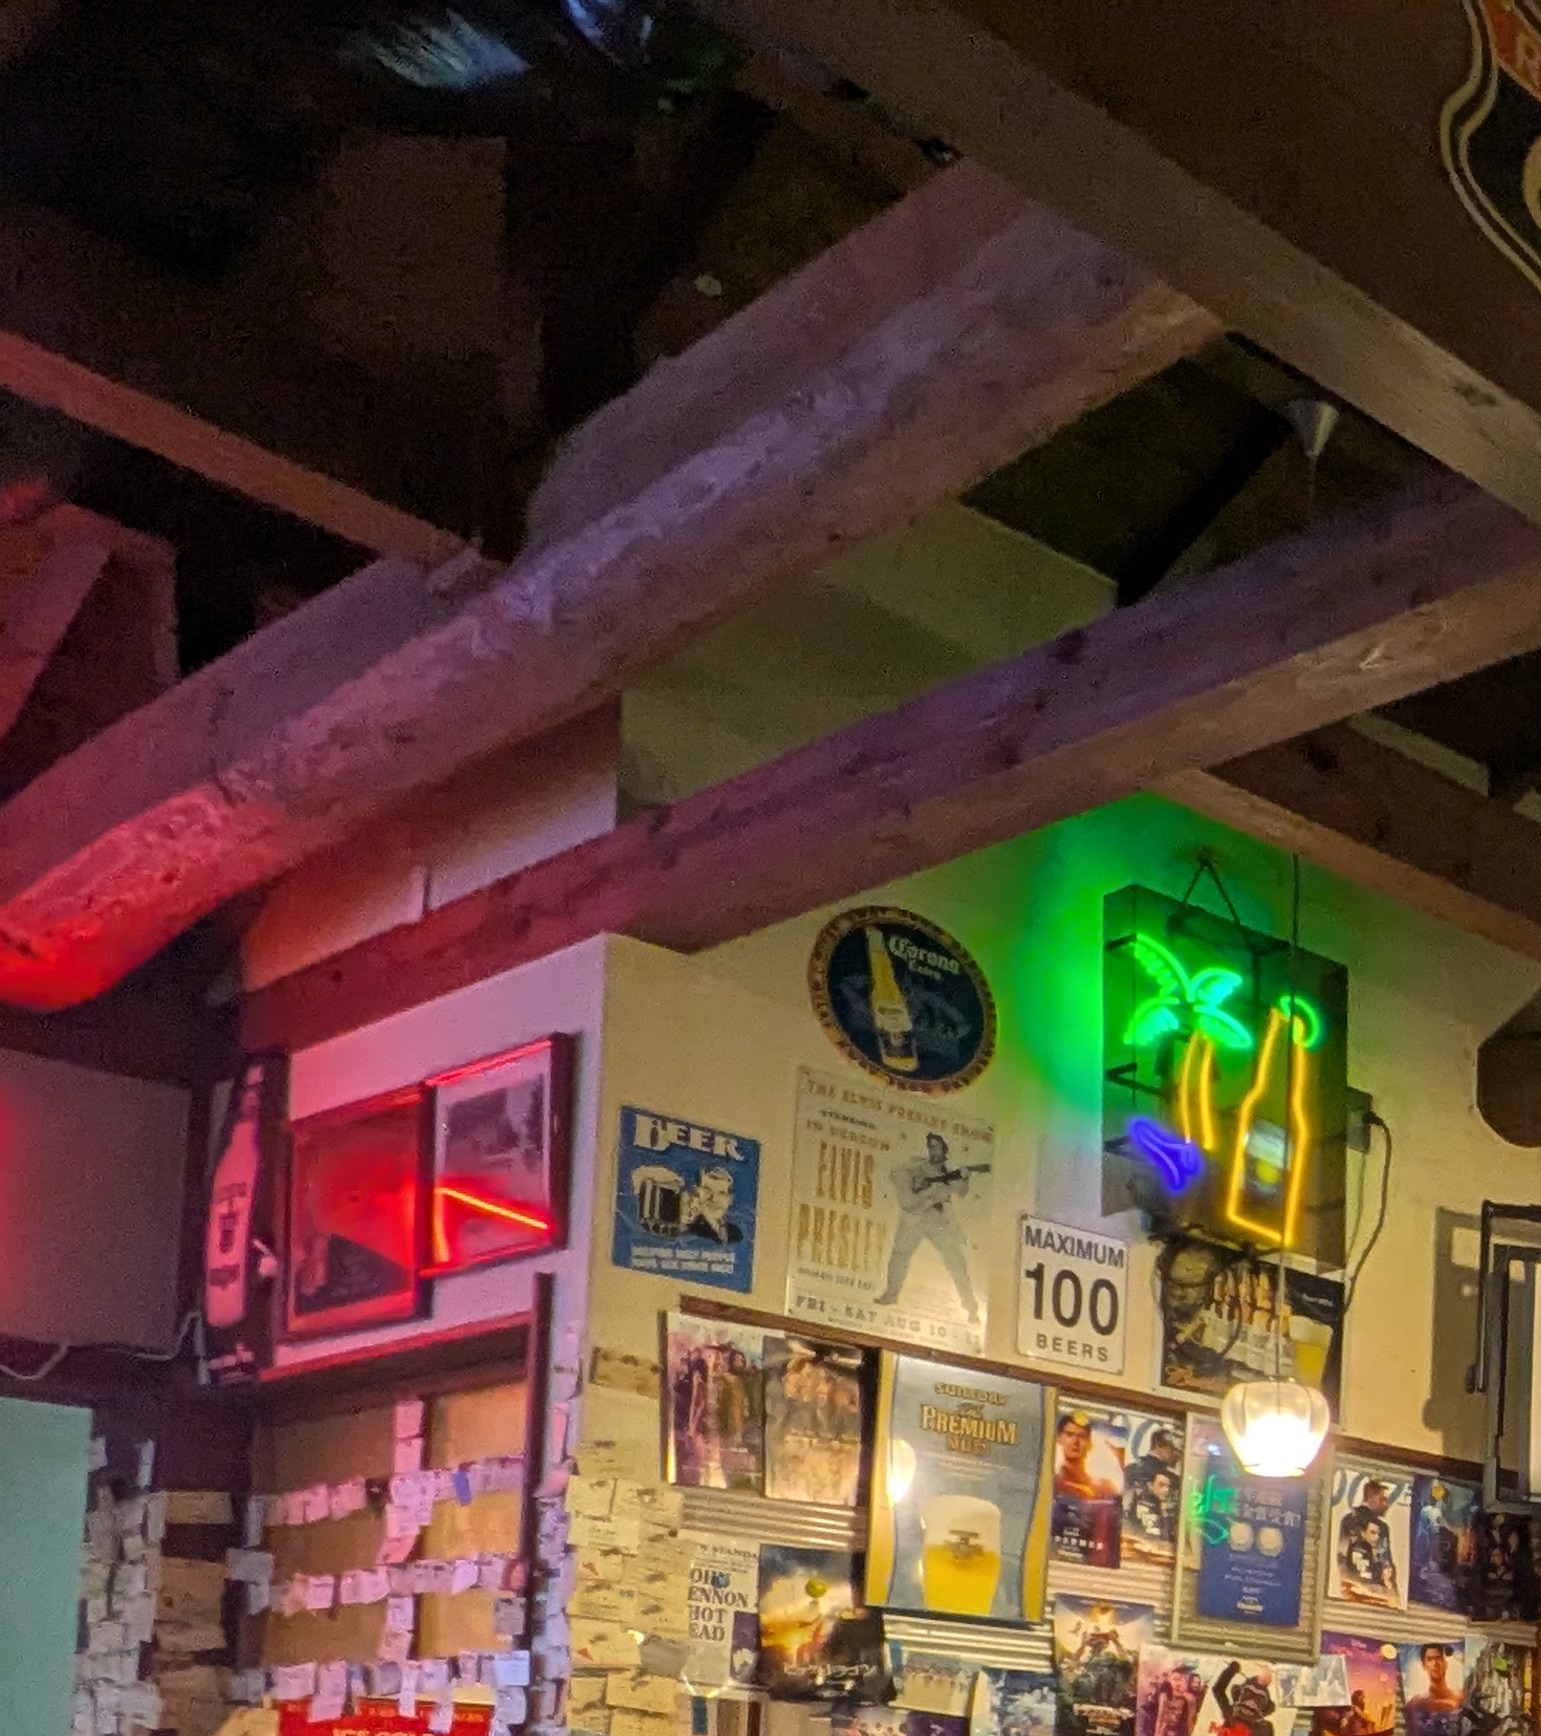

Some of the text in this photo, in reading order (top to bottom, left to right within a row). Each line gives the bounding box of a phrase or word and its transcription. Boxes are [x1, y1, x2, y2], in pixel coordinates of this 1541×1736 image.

[633, 1113, 746, 1162] BEER
[1023, 1222, 1127, 1270] MAXIMUM
[1023, 1261, 1122, 1338] 100
[1034, 1332, 1110, 1364] BEERS
[919, 1402, 1019, 1446] PREMIUM
[688, 1586, 749, 1609] ENNON
[689, 1604, 729, 1623] HOT
[689, 1622, 726, 1642] EAD
